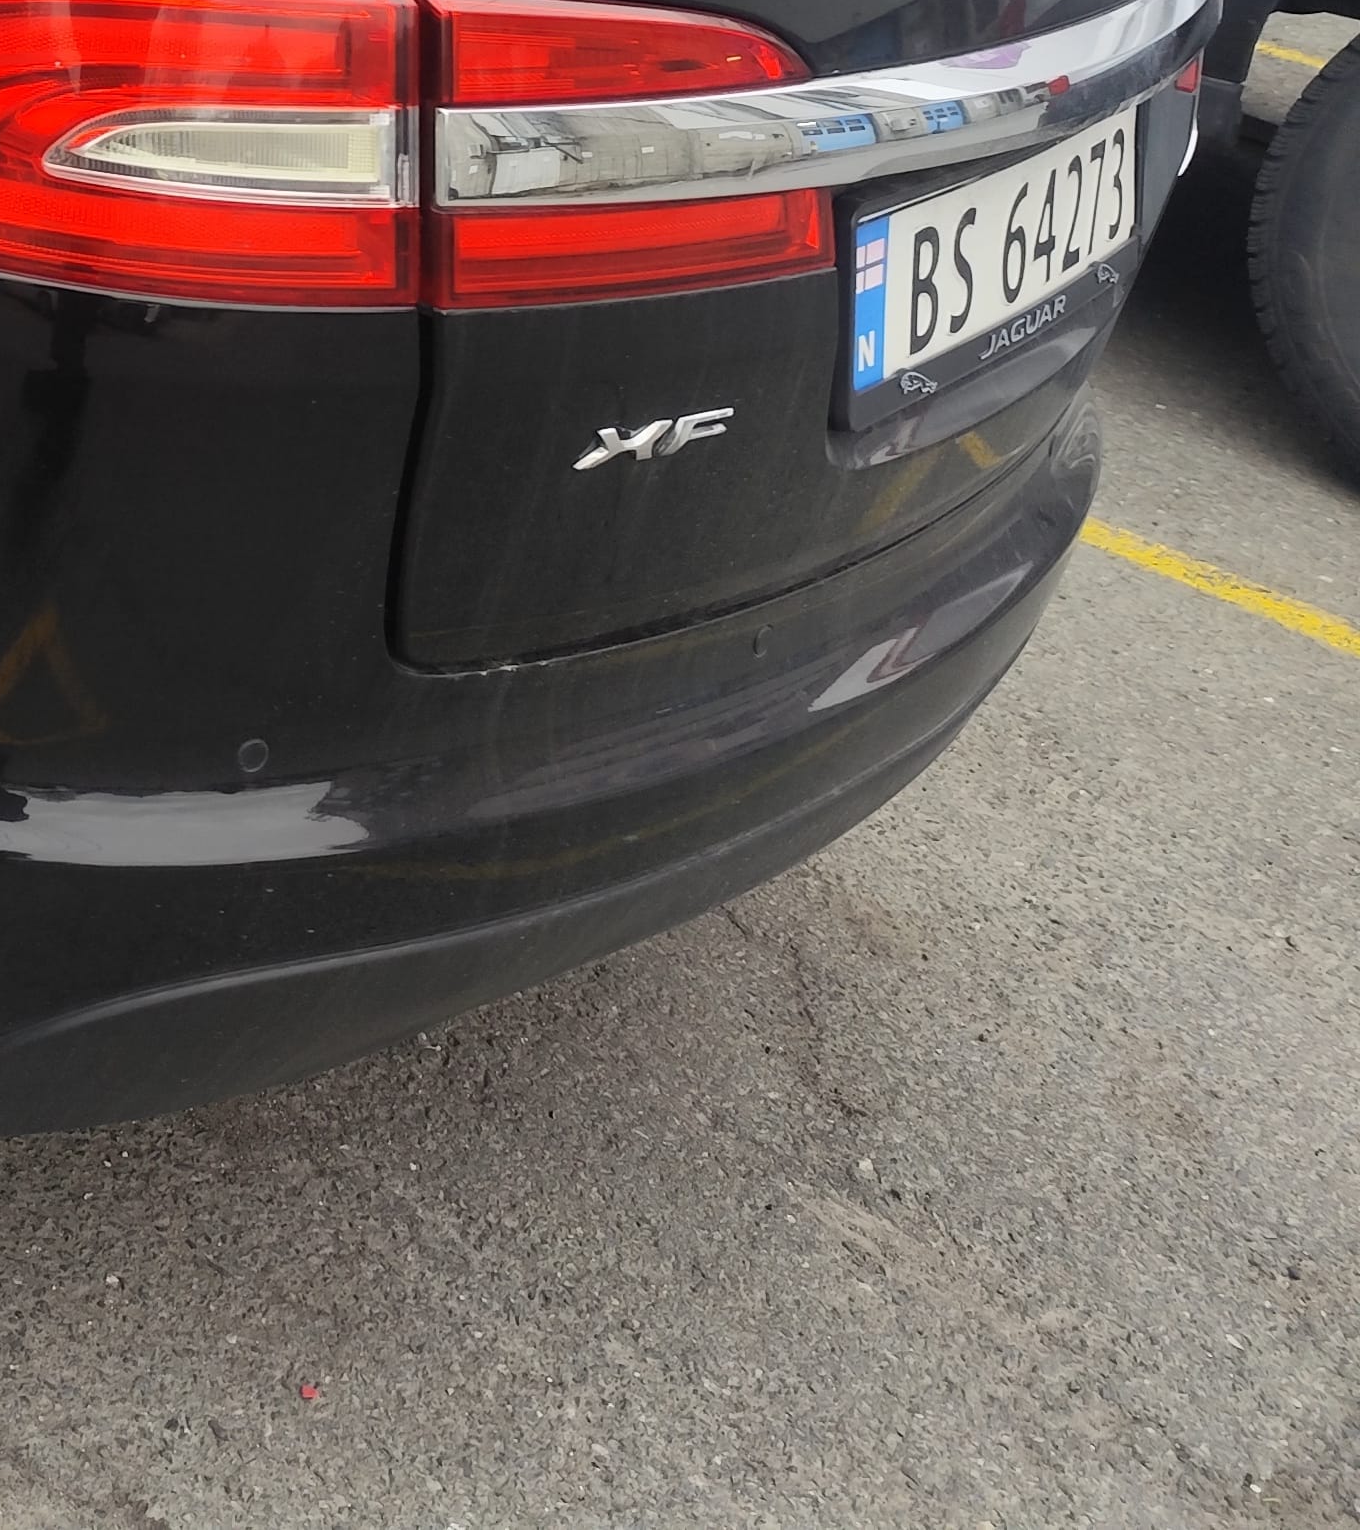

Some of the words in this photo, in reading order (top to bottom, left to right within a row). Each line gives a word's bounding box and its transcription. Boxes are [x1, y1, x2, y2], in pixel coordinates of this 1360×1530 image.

[909, 207, 977, 356] BS
[1002, 128, 1125, 303] 64273
[857, 330, 876, 372] N
[979, 295, 1067, 360] JAGUAR
[572, 407, 734, 470] XF
